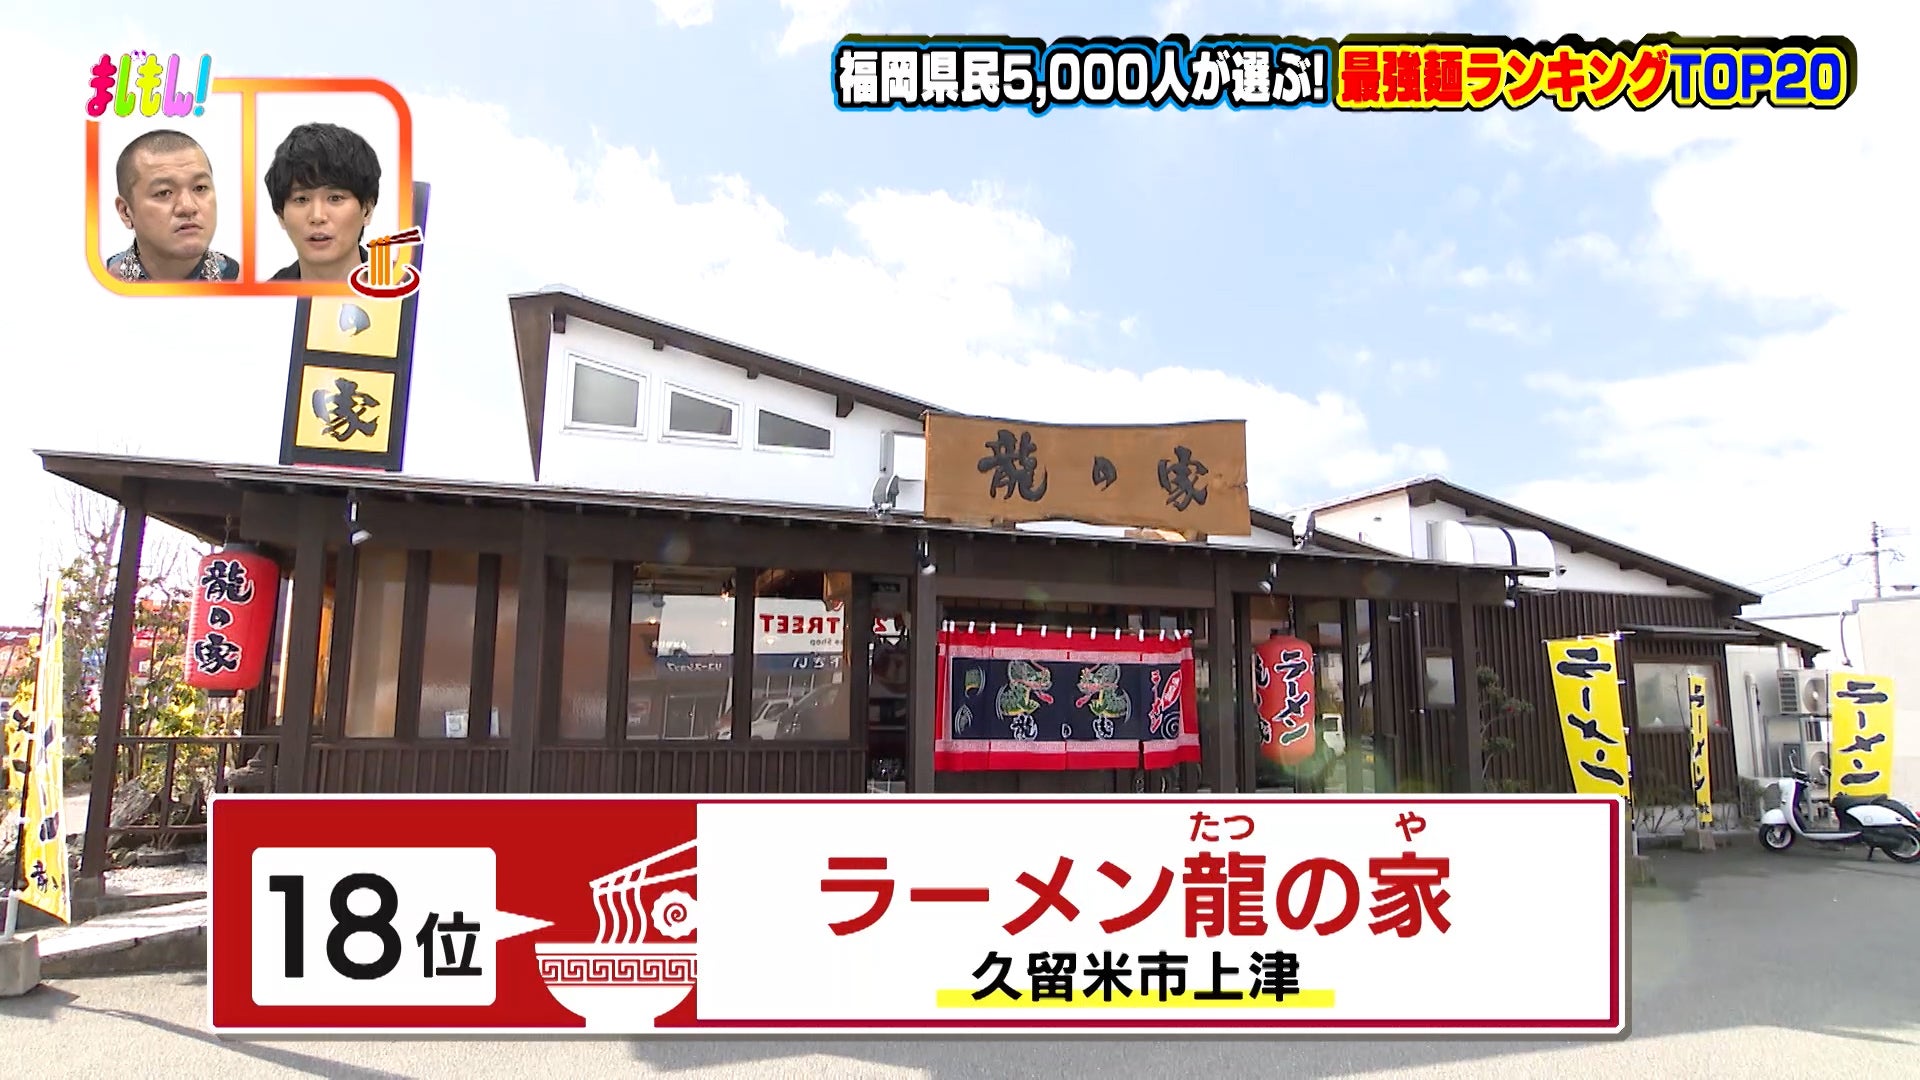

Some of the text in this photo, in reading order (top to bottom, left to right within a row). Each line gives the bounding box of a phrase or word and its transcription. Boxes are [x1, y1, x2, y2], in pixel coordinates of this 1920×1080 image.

[977, 429, 1209, 512] 龍の家
[195, 560, 255, 674] 龍の家
[1272, 649, 1310, 746] ラーメン
[1836, 680, 1889, 786] ラーメン
